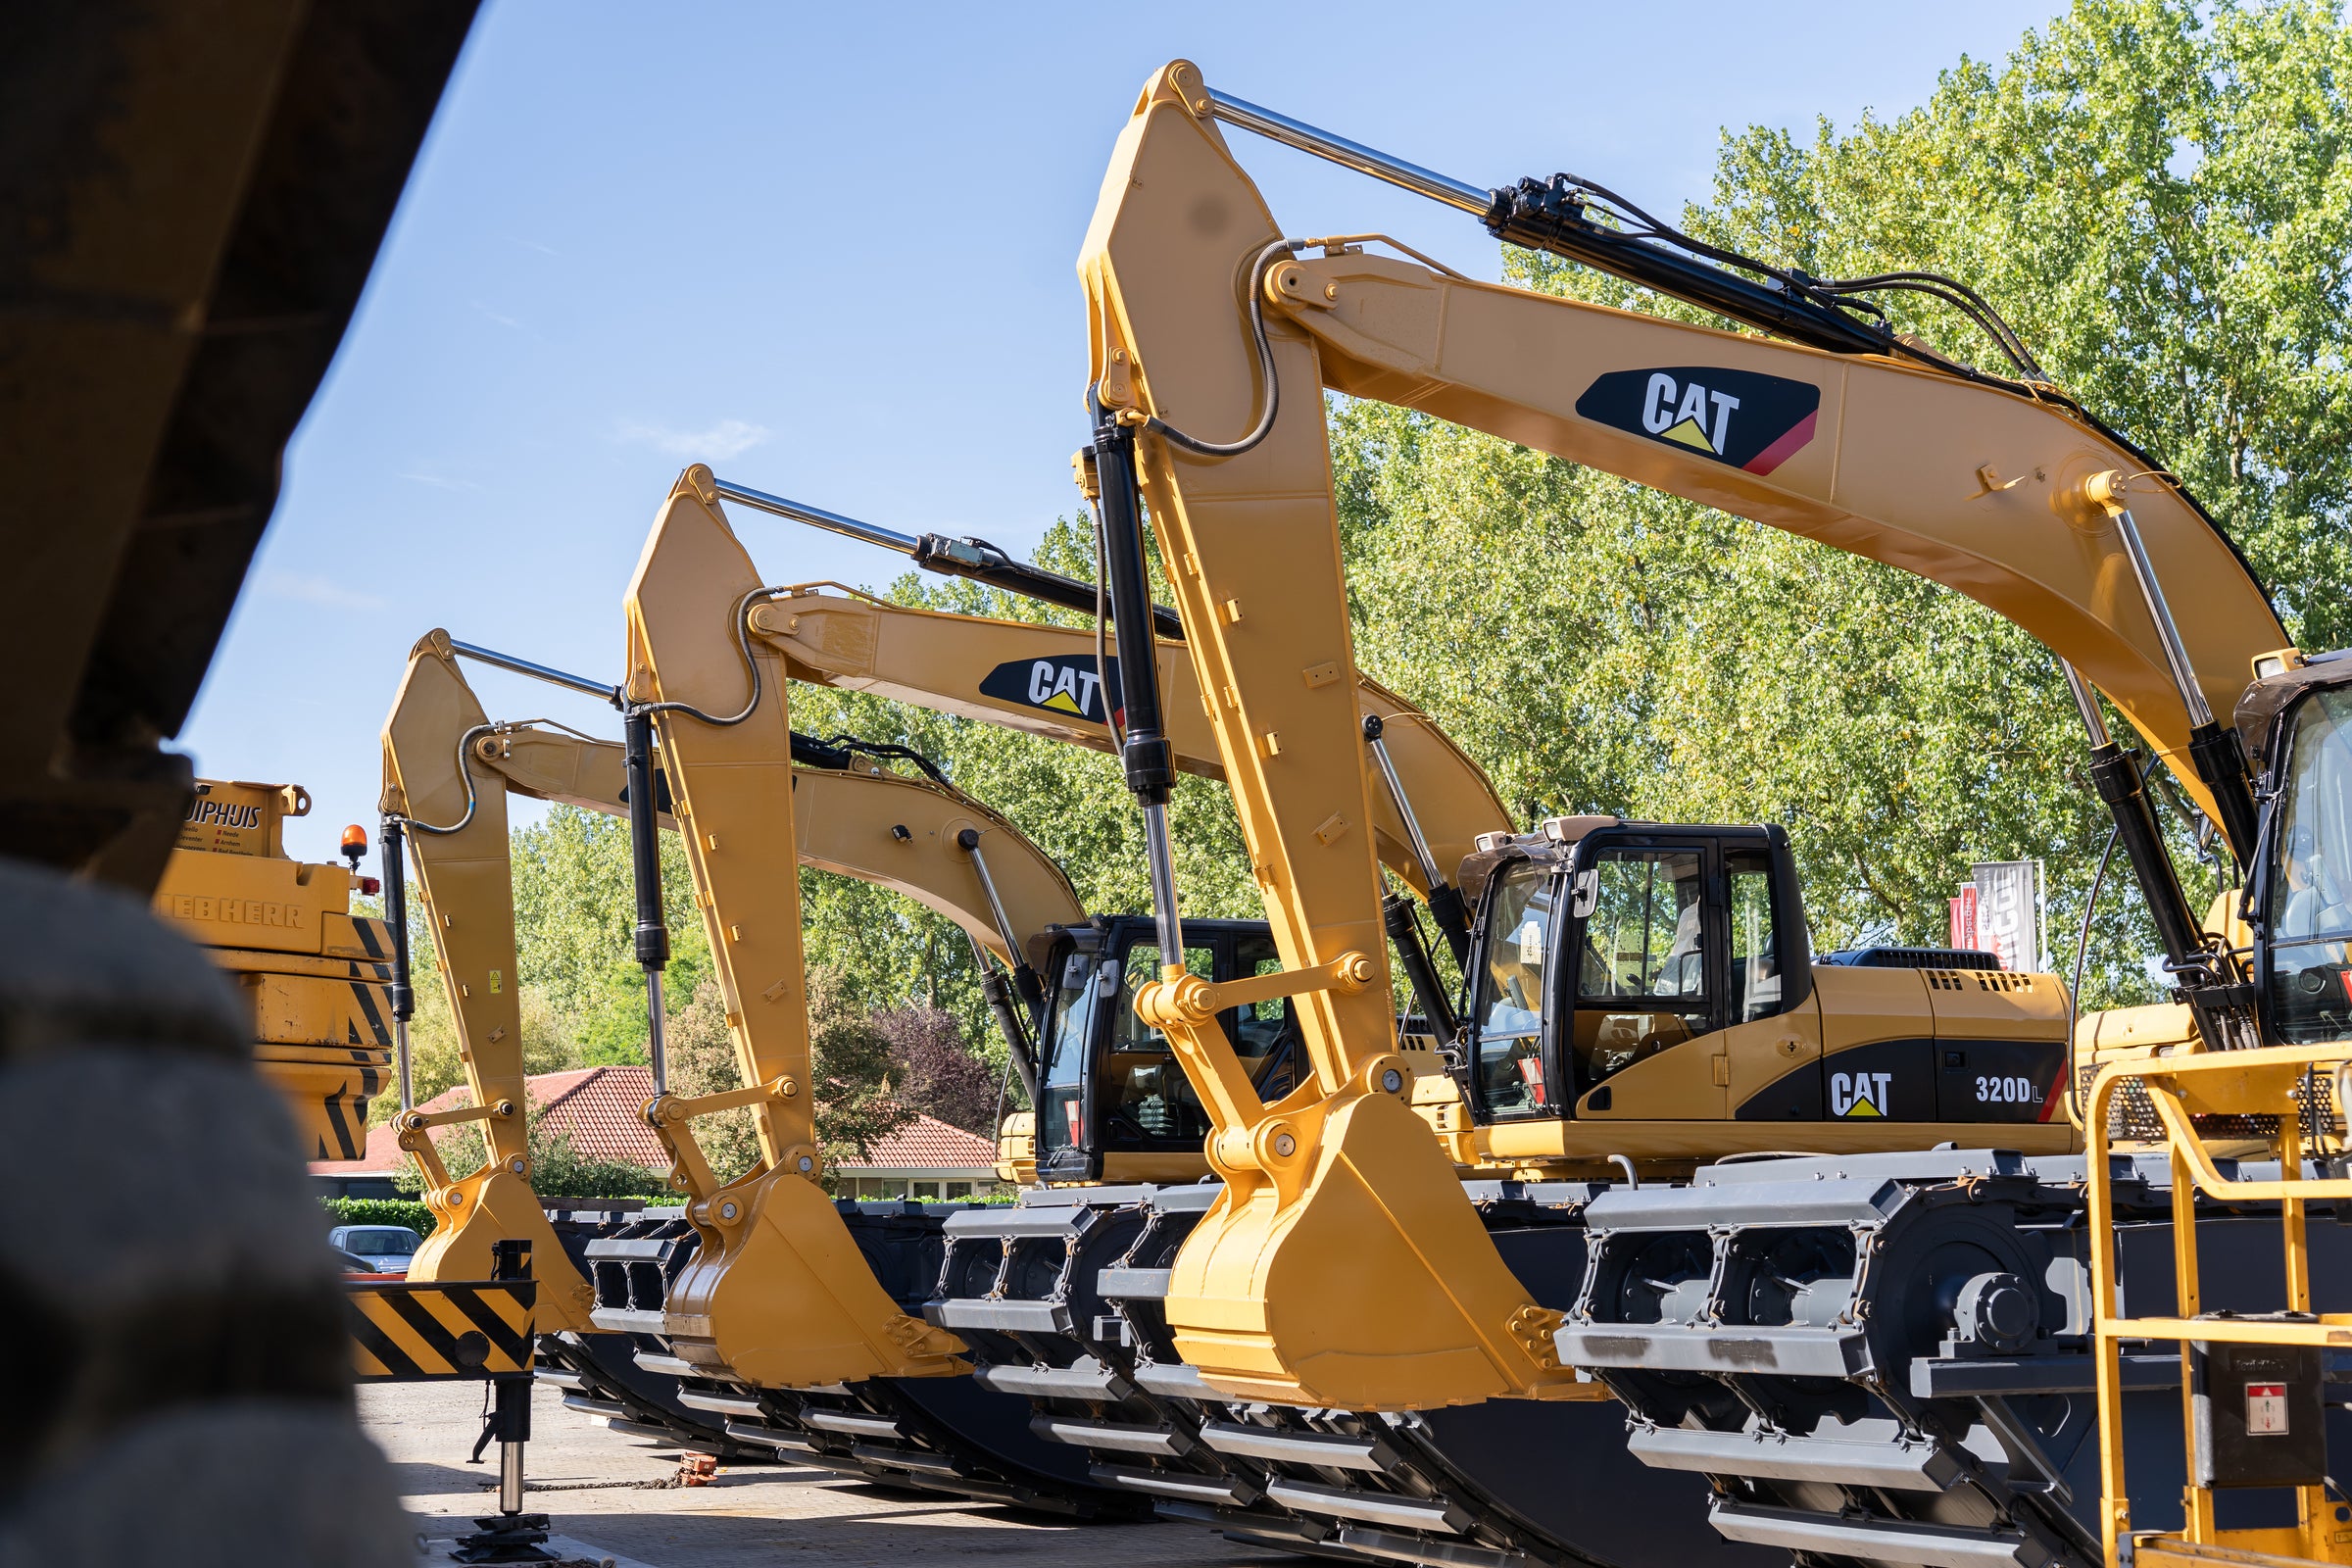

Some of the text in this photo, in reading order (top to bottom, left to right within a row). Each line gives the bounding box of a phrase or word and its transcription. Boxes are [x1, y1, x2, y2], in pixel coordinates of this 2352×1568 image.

[1642, 372, 1740, 456] CAT
[1028, 661, 1100, 716] CAT
[151, 893, 305, 930] IEBHERR
[1831, 1072, 1892, 1117] CAT
